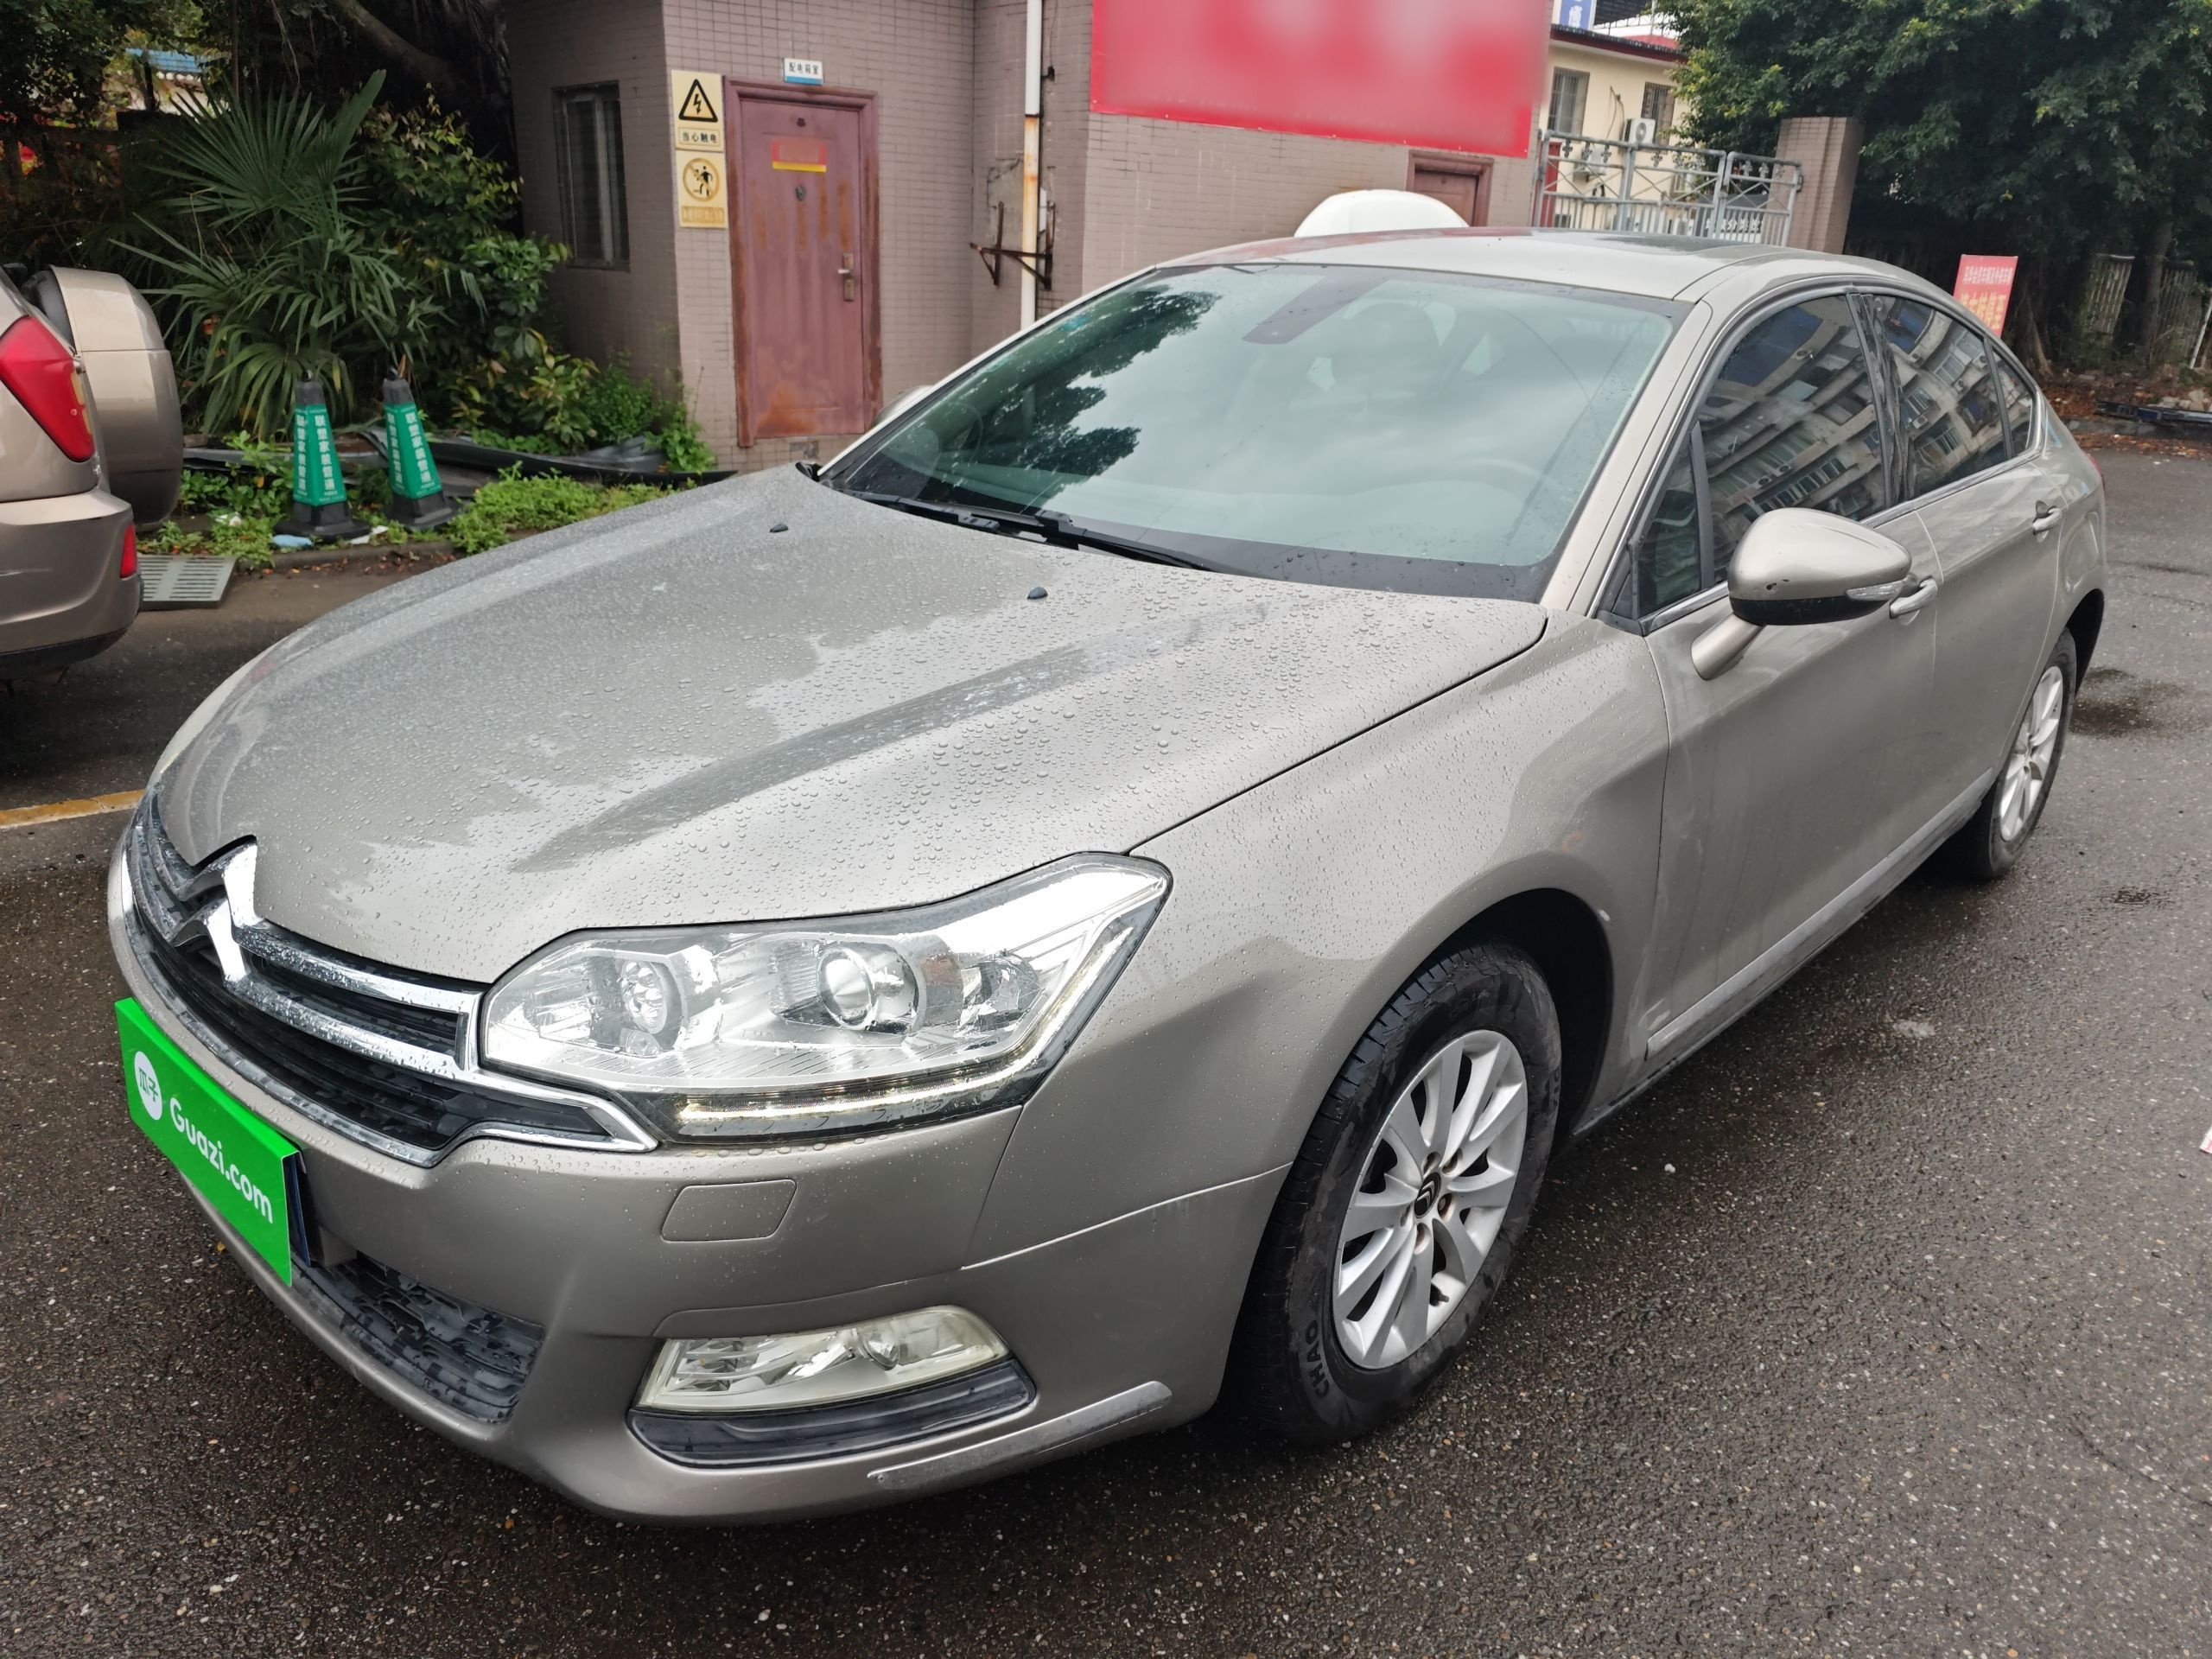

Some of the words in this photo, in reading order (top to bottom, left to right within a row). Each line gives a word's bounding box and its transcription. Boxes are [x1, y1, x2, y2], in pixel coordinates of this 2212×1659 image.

[682, 131, 718, 144] 当心触电
[138, 1067, 159, 1103] 瓜子
[170, 1097, 273, 1224] Guazi.com
[1306, 1319, 1330, 1398] CHAO
